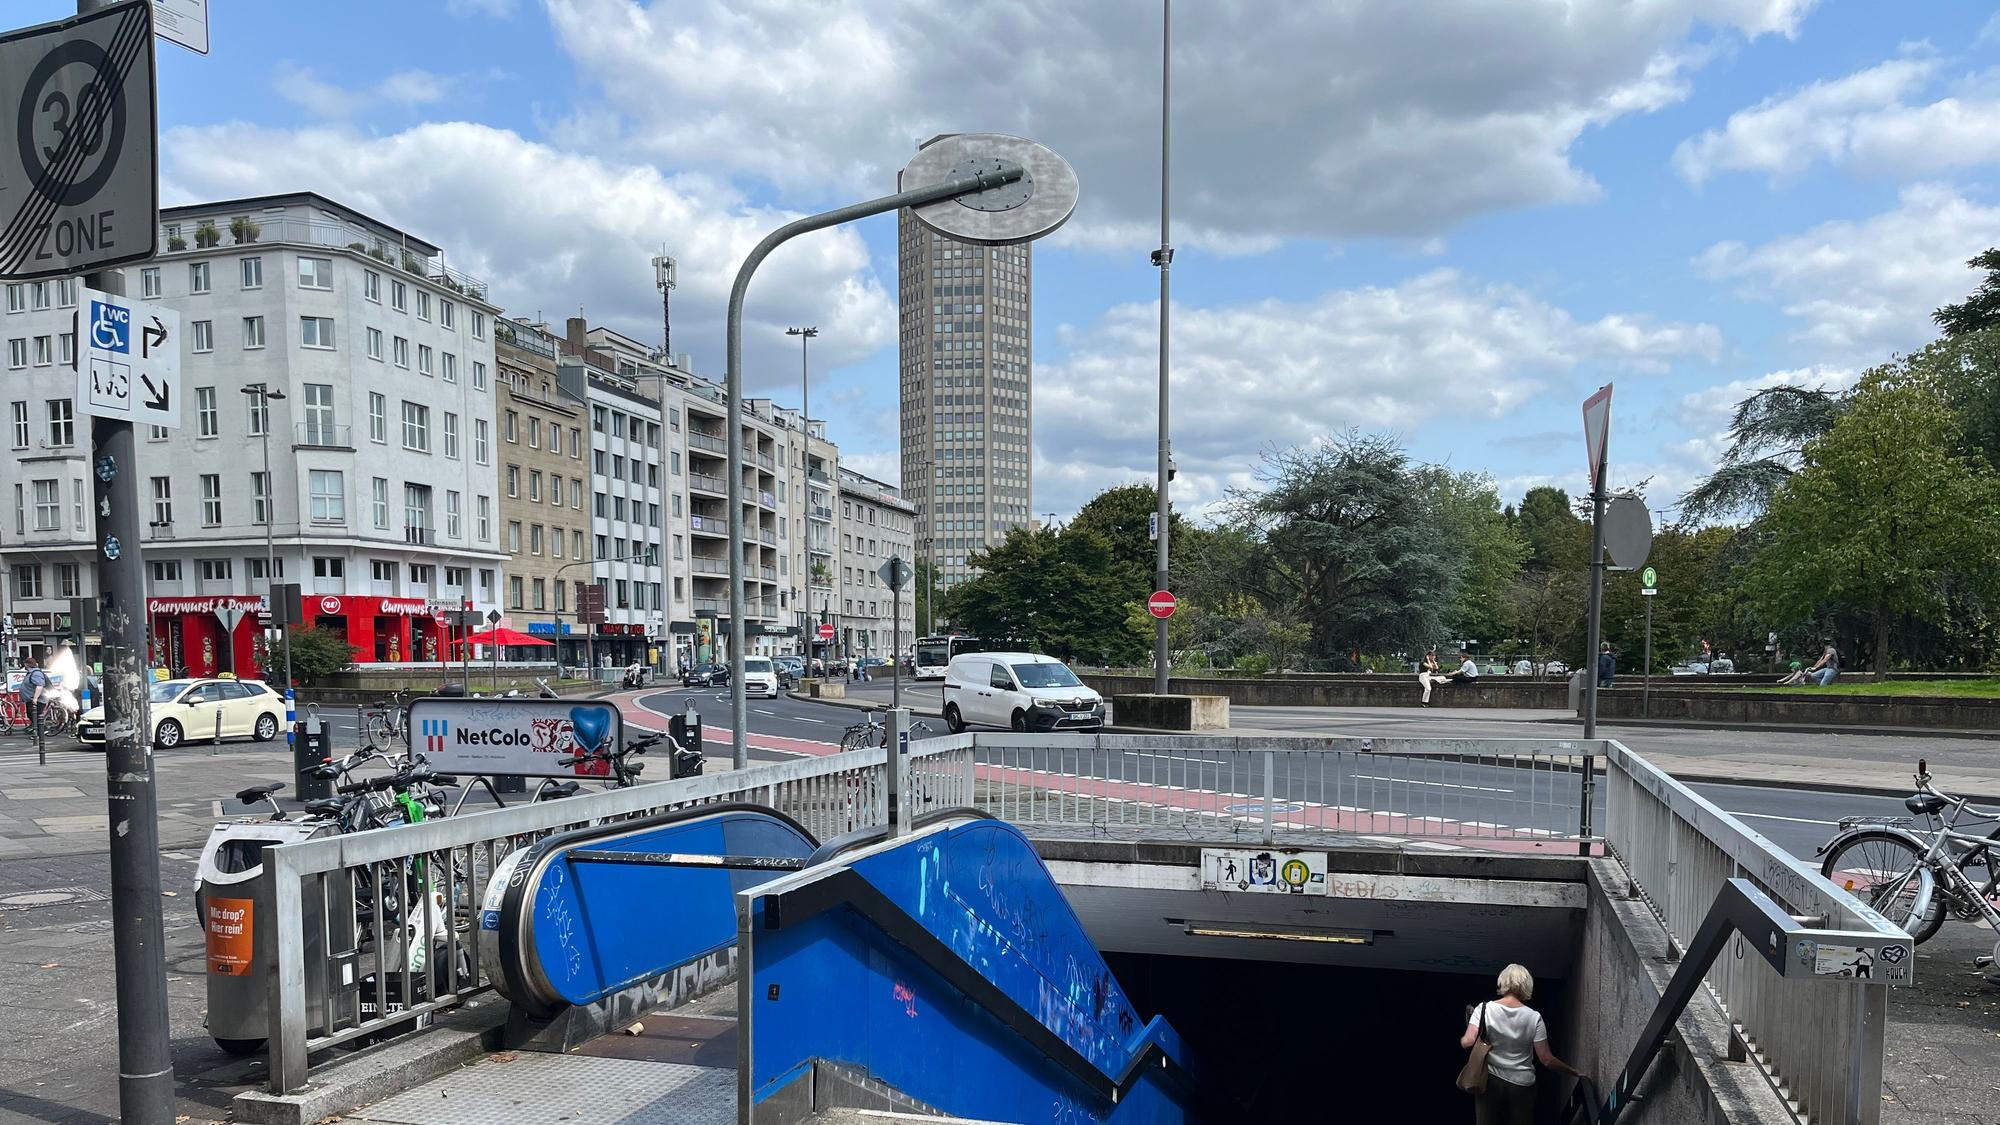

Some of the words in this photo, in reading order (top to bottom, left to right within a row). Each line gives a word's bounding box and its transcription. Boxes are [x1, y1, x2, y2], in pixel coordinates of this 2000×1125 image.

[42, 86, 104, 162] 30
[35, 209, 116, 261] ZONE
[107, 306, 129, 325] WC
[150, 600, 214, 615] Currywurst
[216, 599, 225, 611] &
[381, 600, 429, 616] Currywurst
[602, 624, 622, 633] MIAMI
[210, 906, 221, 919] Mic
[222, 908, 245, 923] drop?
[211, 921, 224, 934] Hier
[225, 923, 243, 935] rein!
